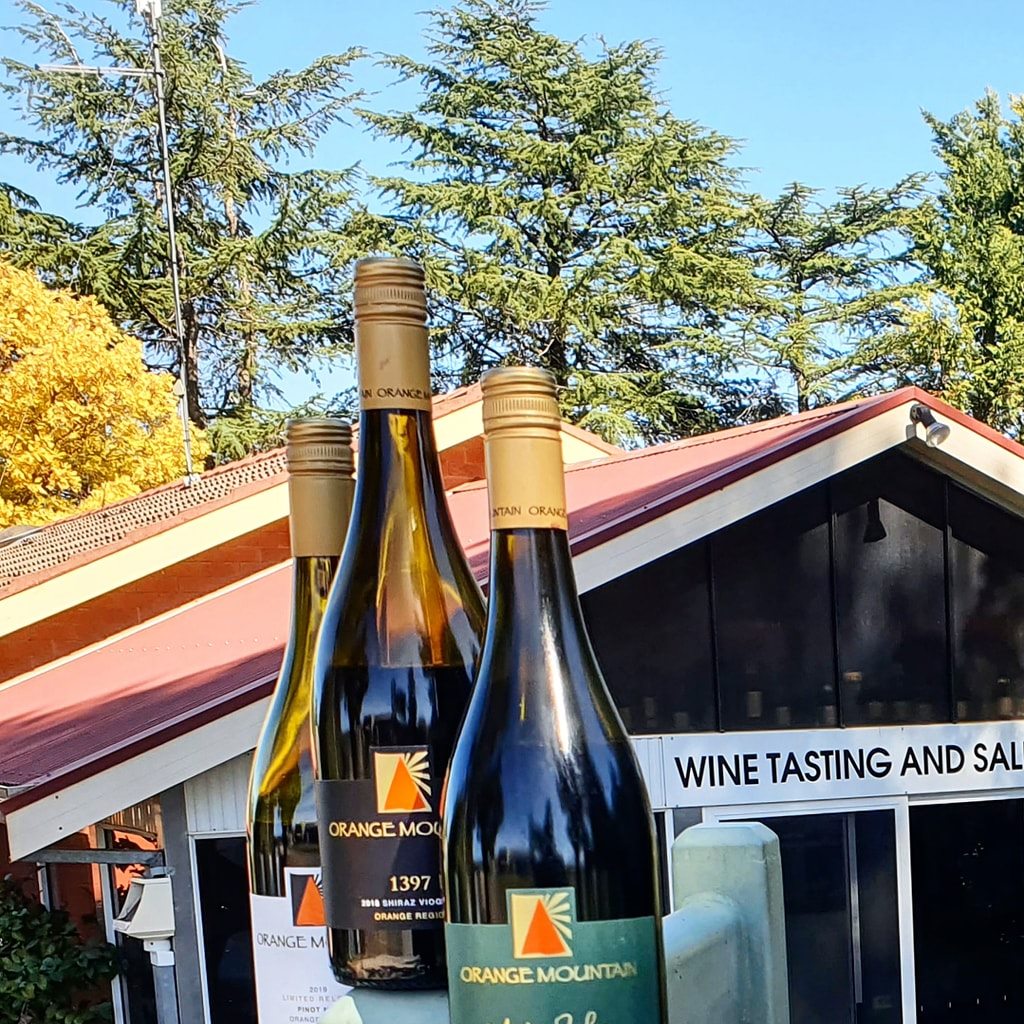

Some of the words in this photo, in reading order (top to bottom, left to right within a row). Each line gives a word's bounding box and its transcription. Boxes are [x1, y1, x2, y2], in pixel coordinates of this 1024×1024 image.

[377, 387, 422, 400] ORANGE
[674, 753, 759, 789] WINE
[767, 746, 893, 784] TASTING
[900, 744, 965, 777] AND
[329, 821, 397, 838] ORANGE
[389, 875, 432, 893] 1397
[382, 898, 417, 908] SHIRAZ
[374, 911, 413, 921] ORANGE
[256, 932, 308, 949] ORANGE
[460, 965, 534, 984] ORANGE
[537, 961, 638, 983] MOUNTAIN
[281, 994, 315, 1003] LIMITED
[297, 1006, 321, 1014] PINOT
